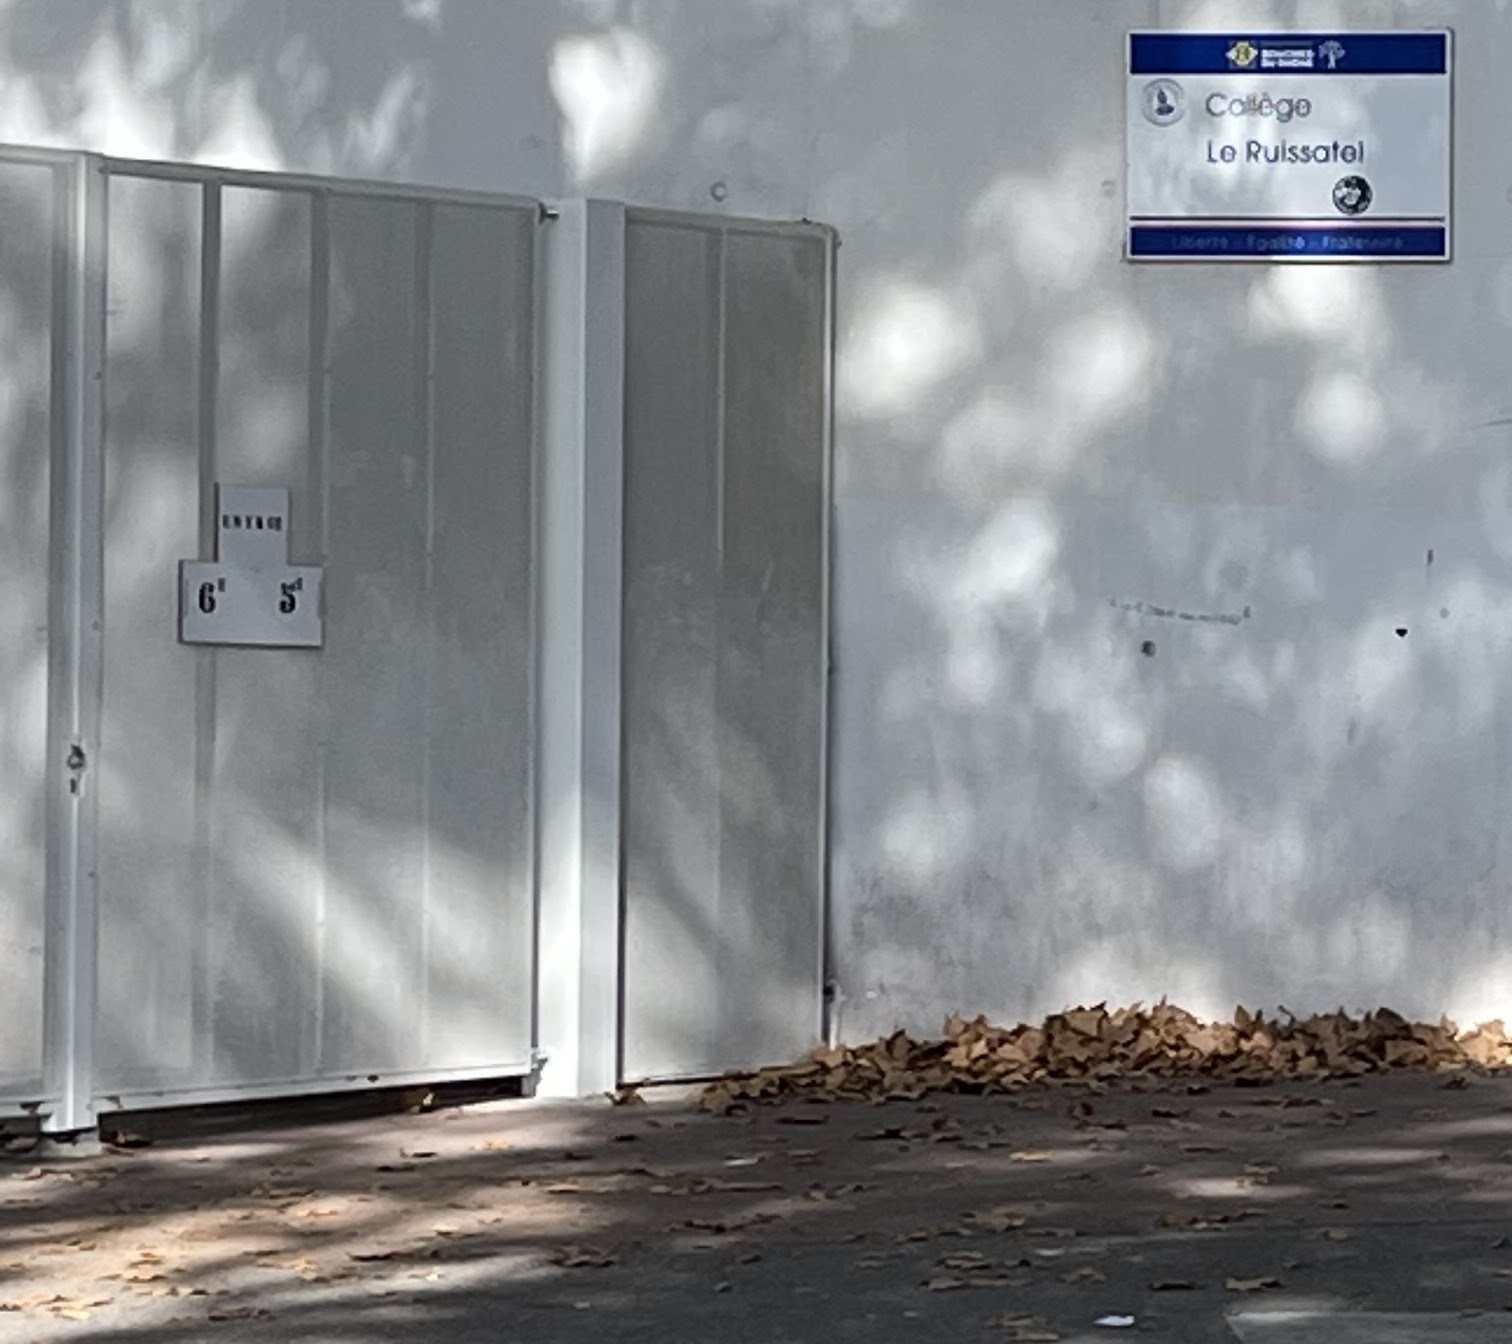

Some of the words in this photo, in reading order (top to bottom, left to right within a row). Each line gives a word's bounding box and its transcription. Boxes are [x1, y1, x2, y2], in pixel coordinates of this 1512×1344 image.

[1206, 92, 1312, 123] Collège
[1207, 139, 1237, 164] Le
[1246, 139, 1364, 164] Ruissatel
